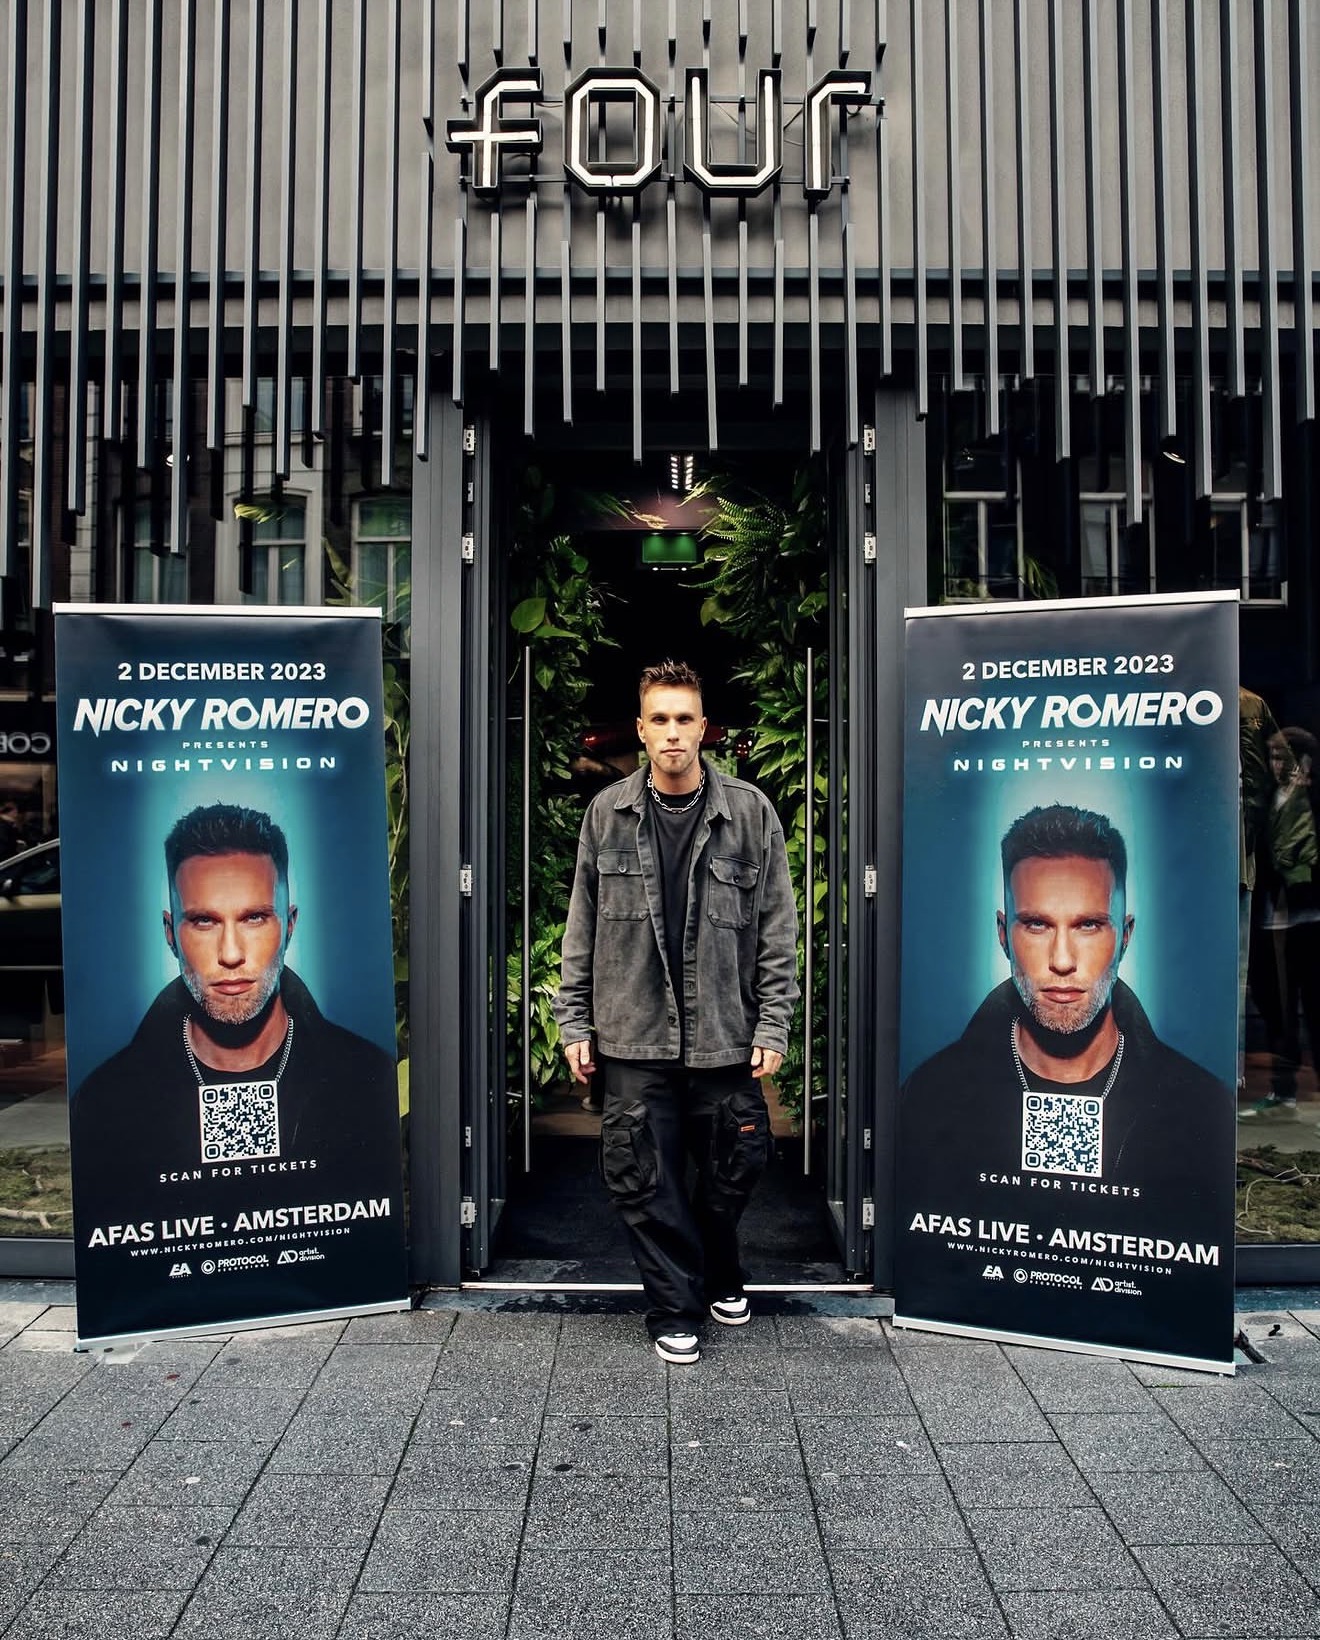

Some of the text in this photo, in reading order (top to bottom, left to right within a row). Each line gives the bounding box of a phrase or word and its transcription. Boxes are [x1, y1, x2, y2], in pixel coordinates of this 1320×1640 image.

[118, 662, 326, 681] 2 DECEMBER 2023
[962, 654, 1174, 680] 2 DECEMBER 2023
[73, 696, 370, 737] NICKY ROMERO
[919, 690, 1223, 738] NICKY ROMERO
[182, 740, 268, 749] PRESENTS
[1022, 739, 1110, 748] PRESENTS
[111, 757, 335, 772] NIGHTVISION
[954, 756, 1182, 771] NIGHTVISION
[159, 1159, 317, 1183] SCAN FOR TICKETS
[979, 1172, 1140, 1197] SCAN FOR TICKETS
[87, 1197, 391, 1248] AFAS LIVE AMSTERDAM
[130, 1227, 351, 1257] WWW.NICKYROMERO.COM/NIGHTVISION
[909, 1212, 1220, 1266] AFAS LIVE AMSTERDAM
[217, 1254, 270, 1268] PROTOCOL
[947, 1242, 1173, 1275] WWW.NICKYROMERO.COM/NIGHTVISION
[1030, 1270, 1083, 1286] PROTOCOL
